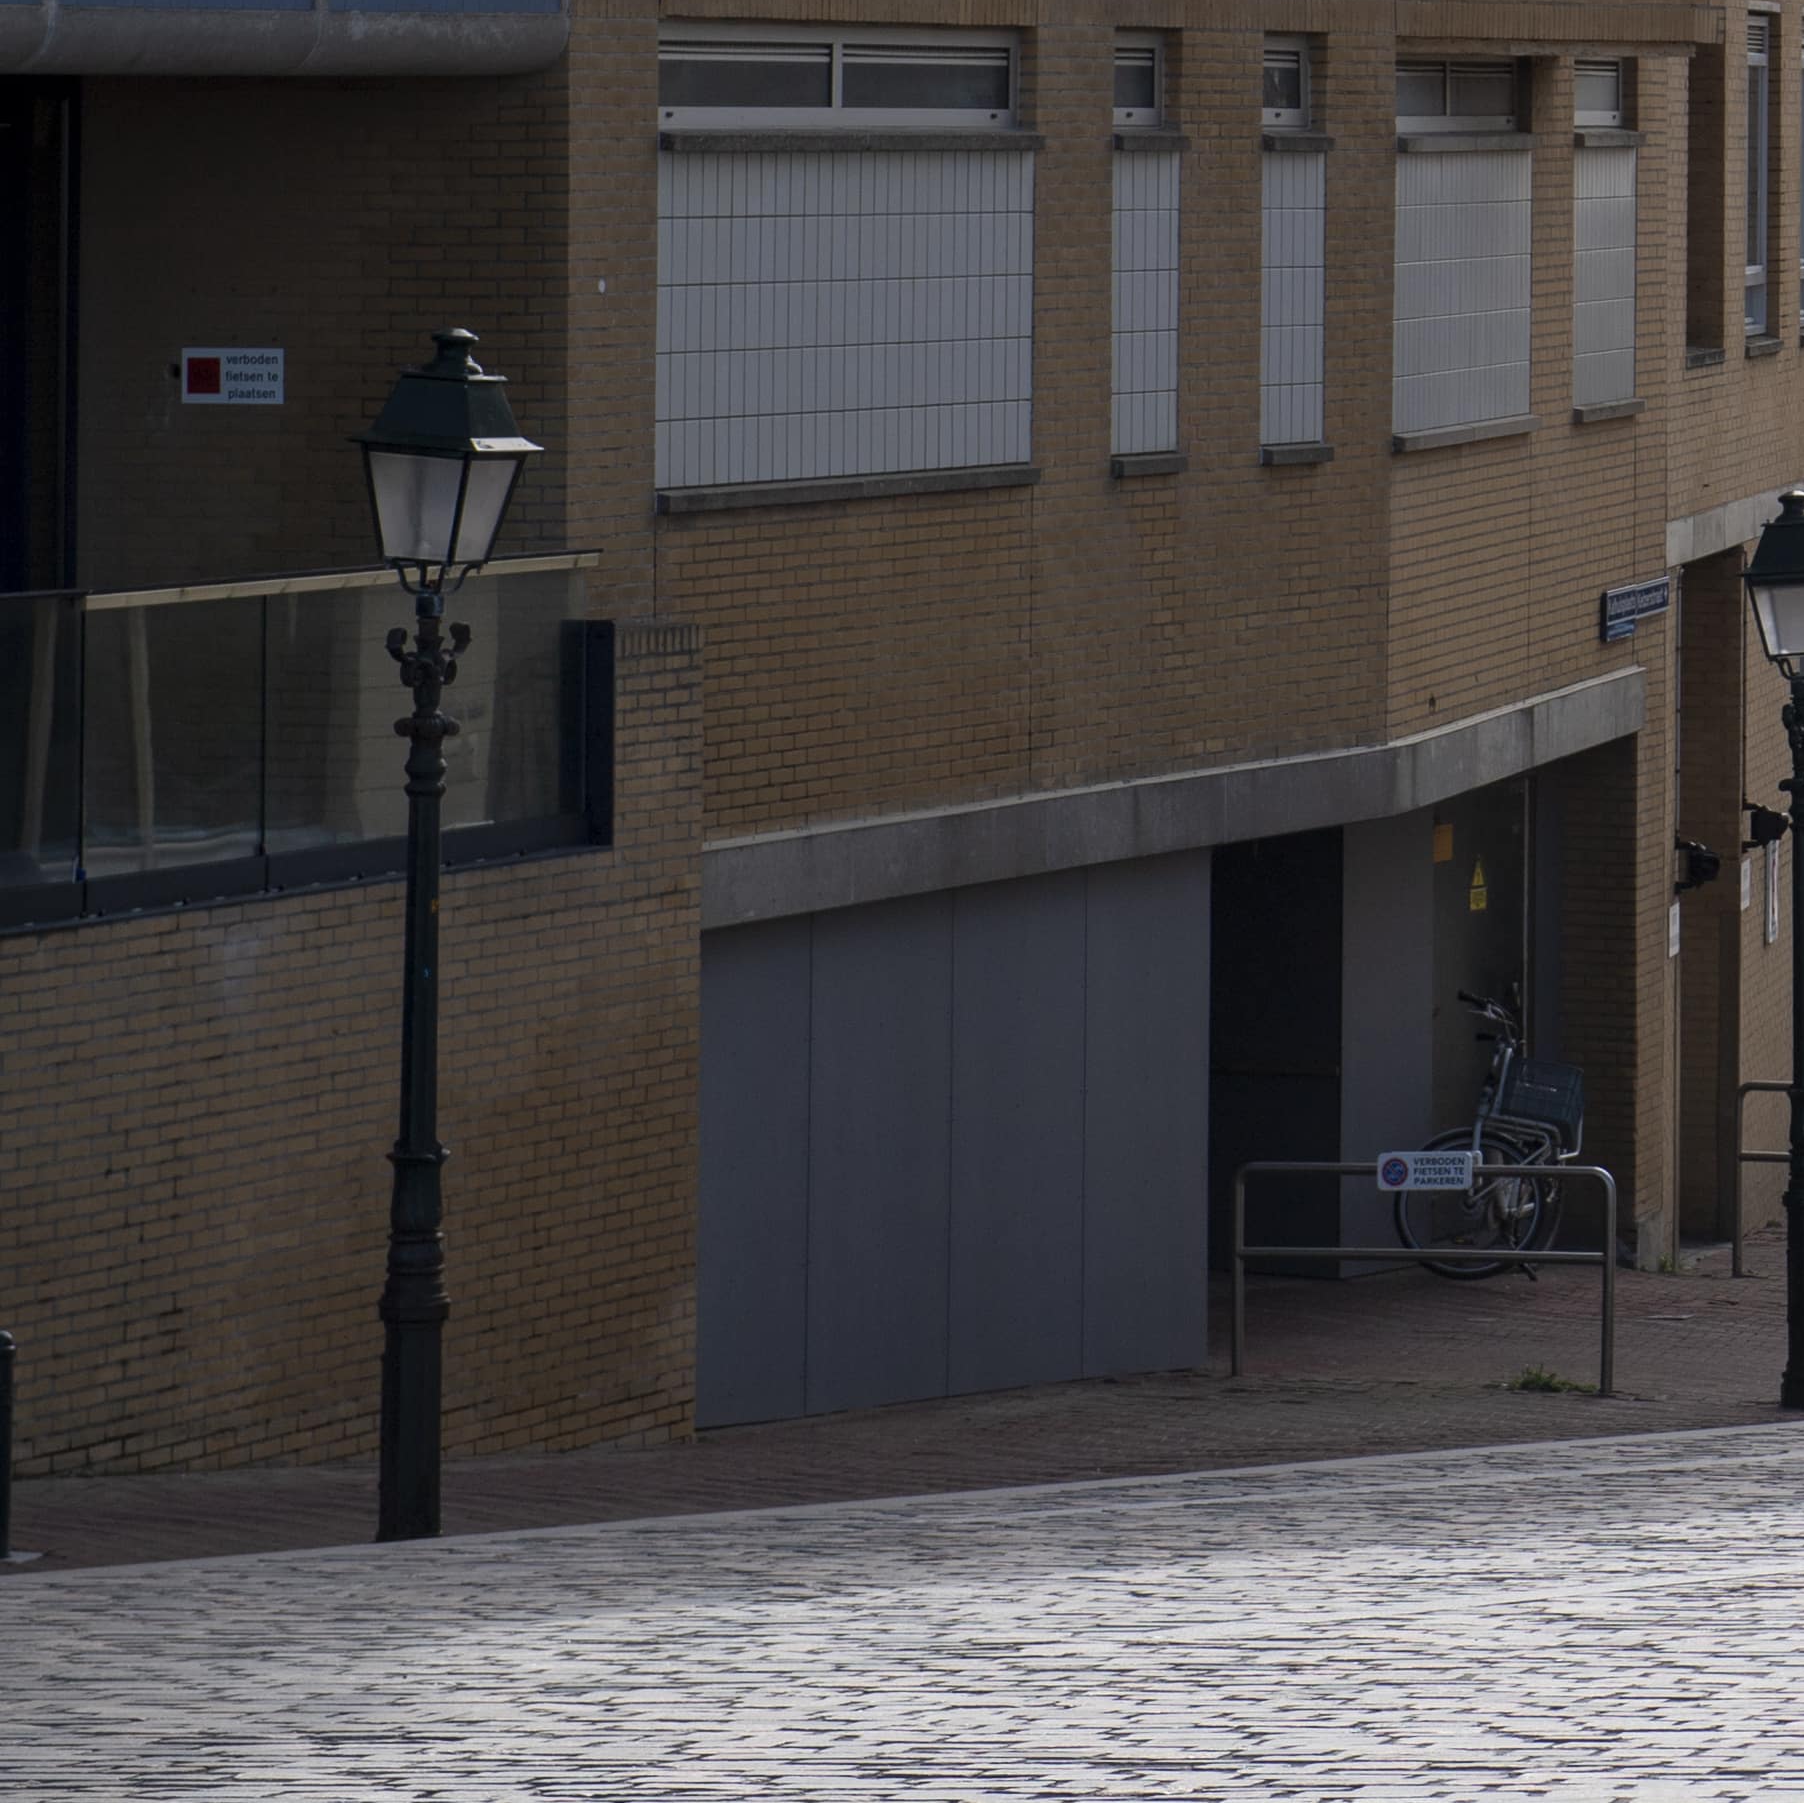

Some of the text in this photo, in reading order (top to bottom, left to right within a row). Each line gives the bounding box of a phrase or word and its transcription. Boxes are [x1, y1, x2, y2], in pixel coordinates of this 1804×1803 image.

[225, 354, 278, 365] verboden
[225, 371, 279, 382] fietsen te
[228, 387, 276, 400] plaatsen
[1413, 1157, 1465, 1166] VERBODEN
[1413, 1167, 1465, 1176] FIETSEN TE
[1413, 1177, 1465, 1186] PARKEREN
